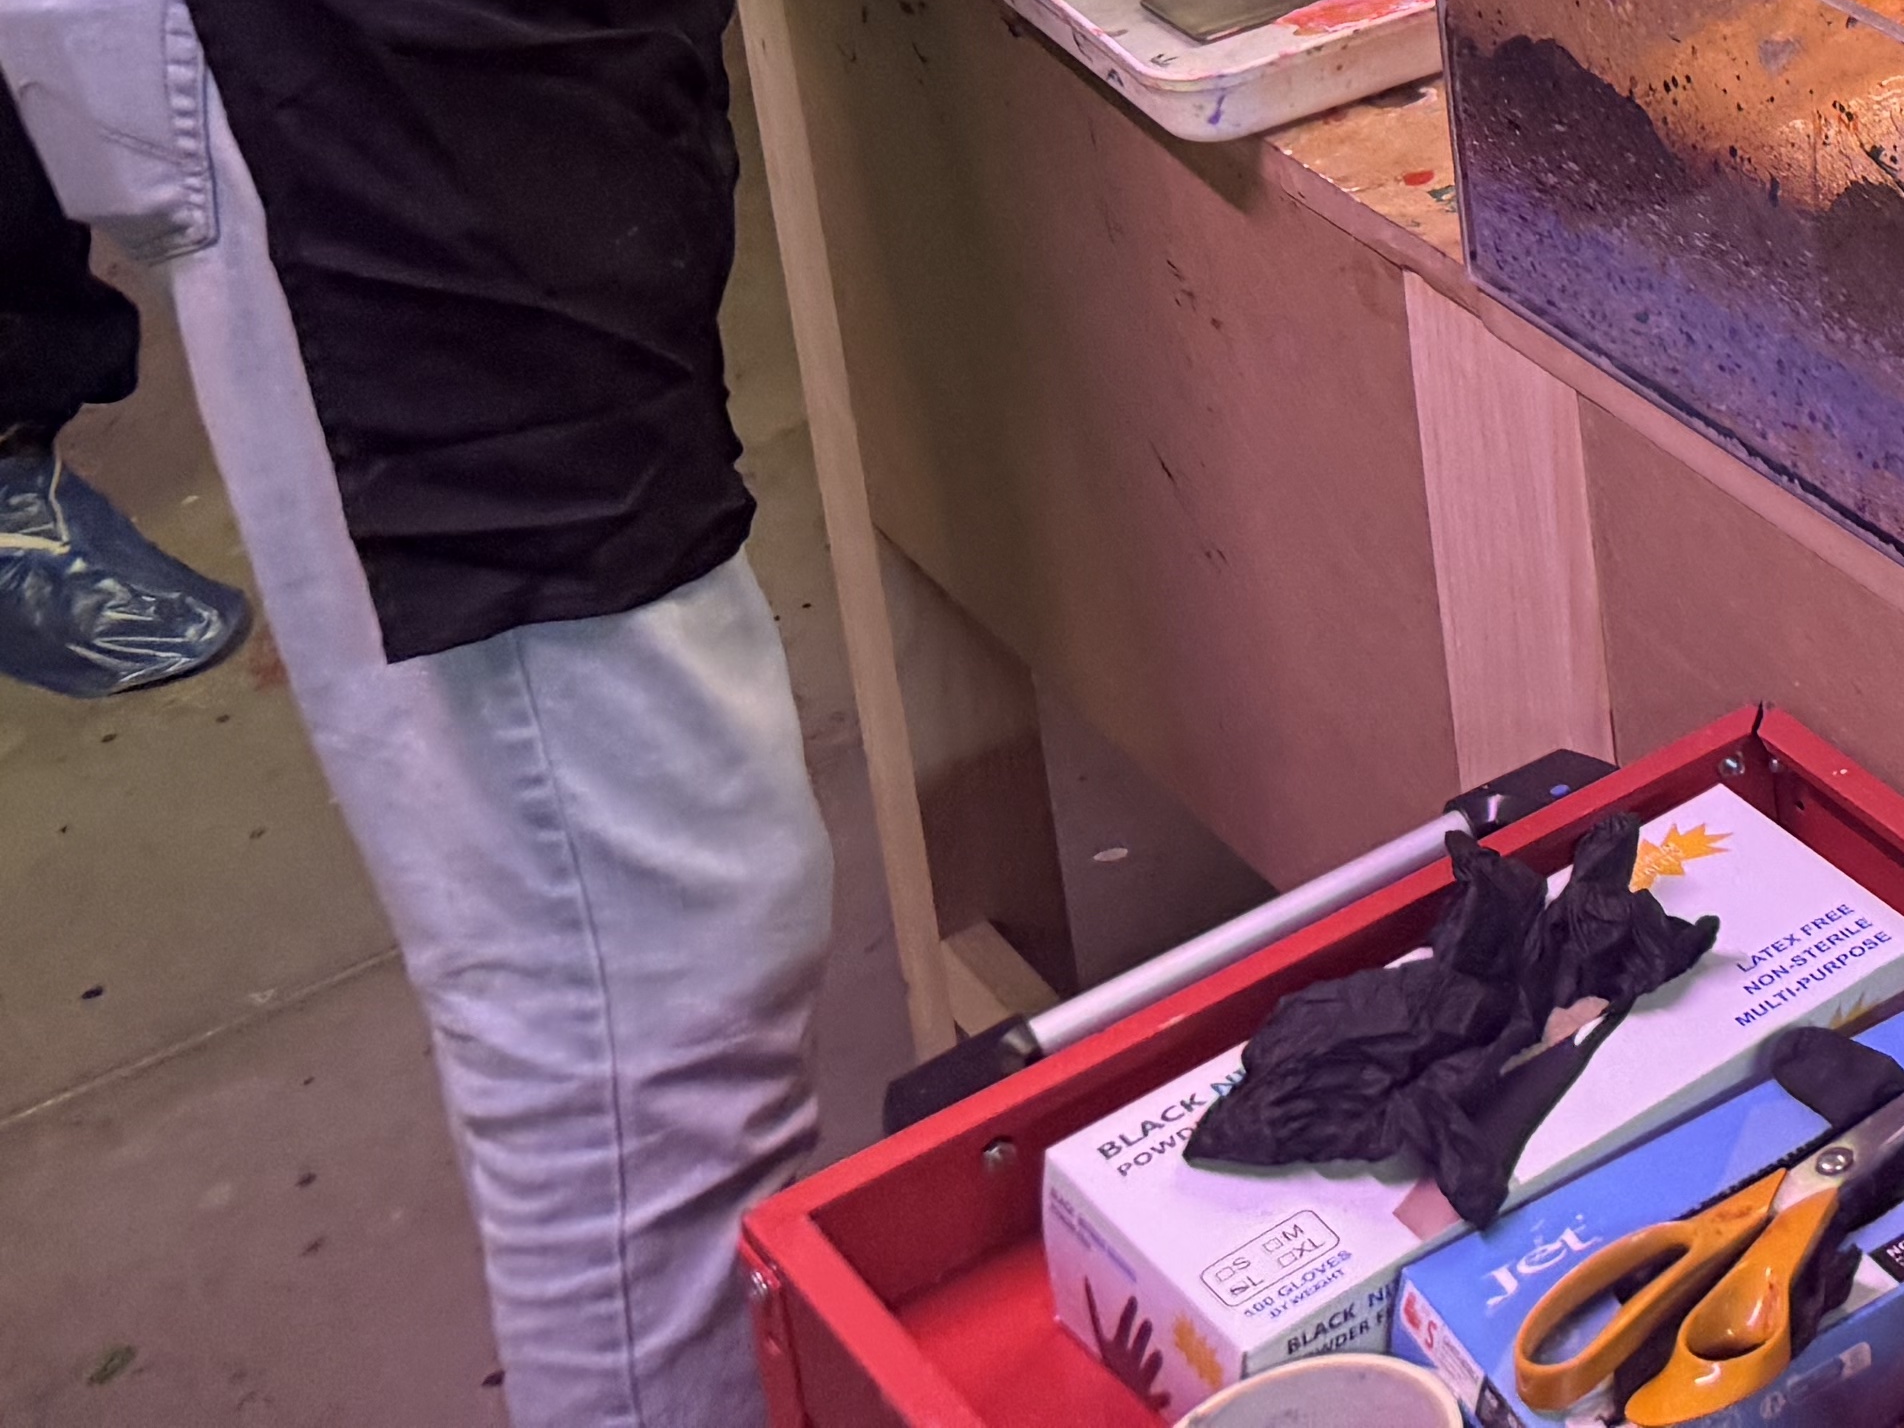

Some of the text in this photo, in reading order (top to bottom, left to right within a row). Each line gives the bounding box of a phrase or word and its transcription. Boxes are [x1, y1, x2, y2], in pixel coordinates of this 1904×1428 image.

[1736, 903, 1855, 974] LATEX FREE
[1743, 917, 1874, 995] NON-STERILE
[1734, 930, 1893, 1027] MULTI-PURPOSE
[1096, 1092, 1208, 1162] BLACK
[1115, 1122, 1198, 1178] POWD
[1228, 1224, 1306, 1277] S M
[1276, 1249, 1354, 1298] GLOVES
[1293, 1237, 1327, 1261] XL
[1286, 1302, 1358, 1357] BLACK
